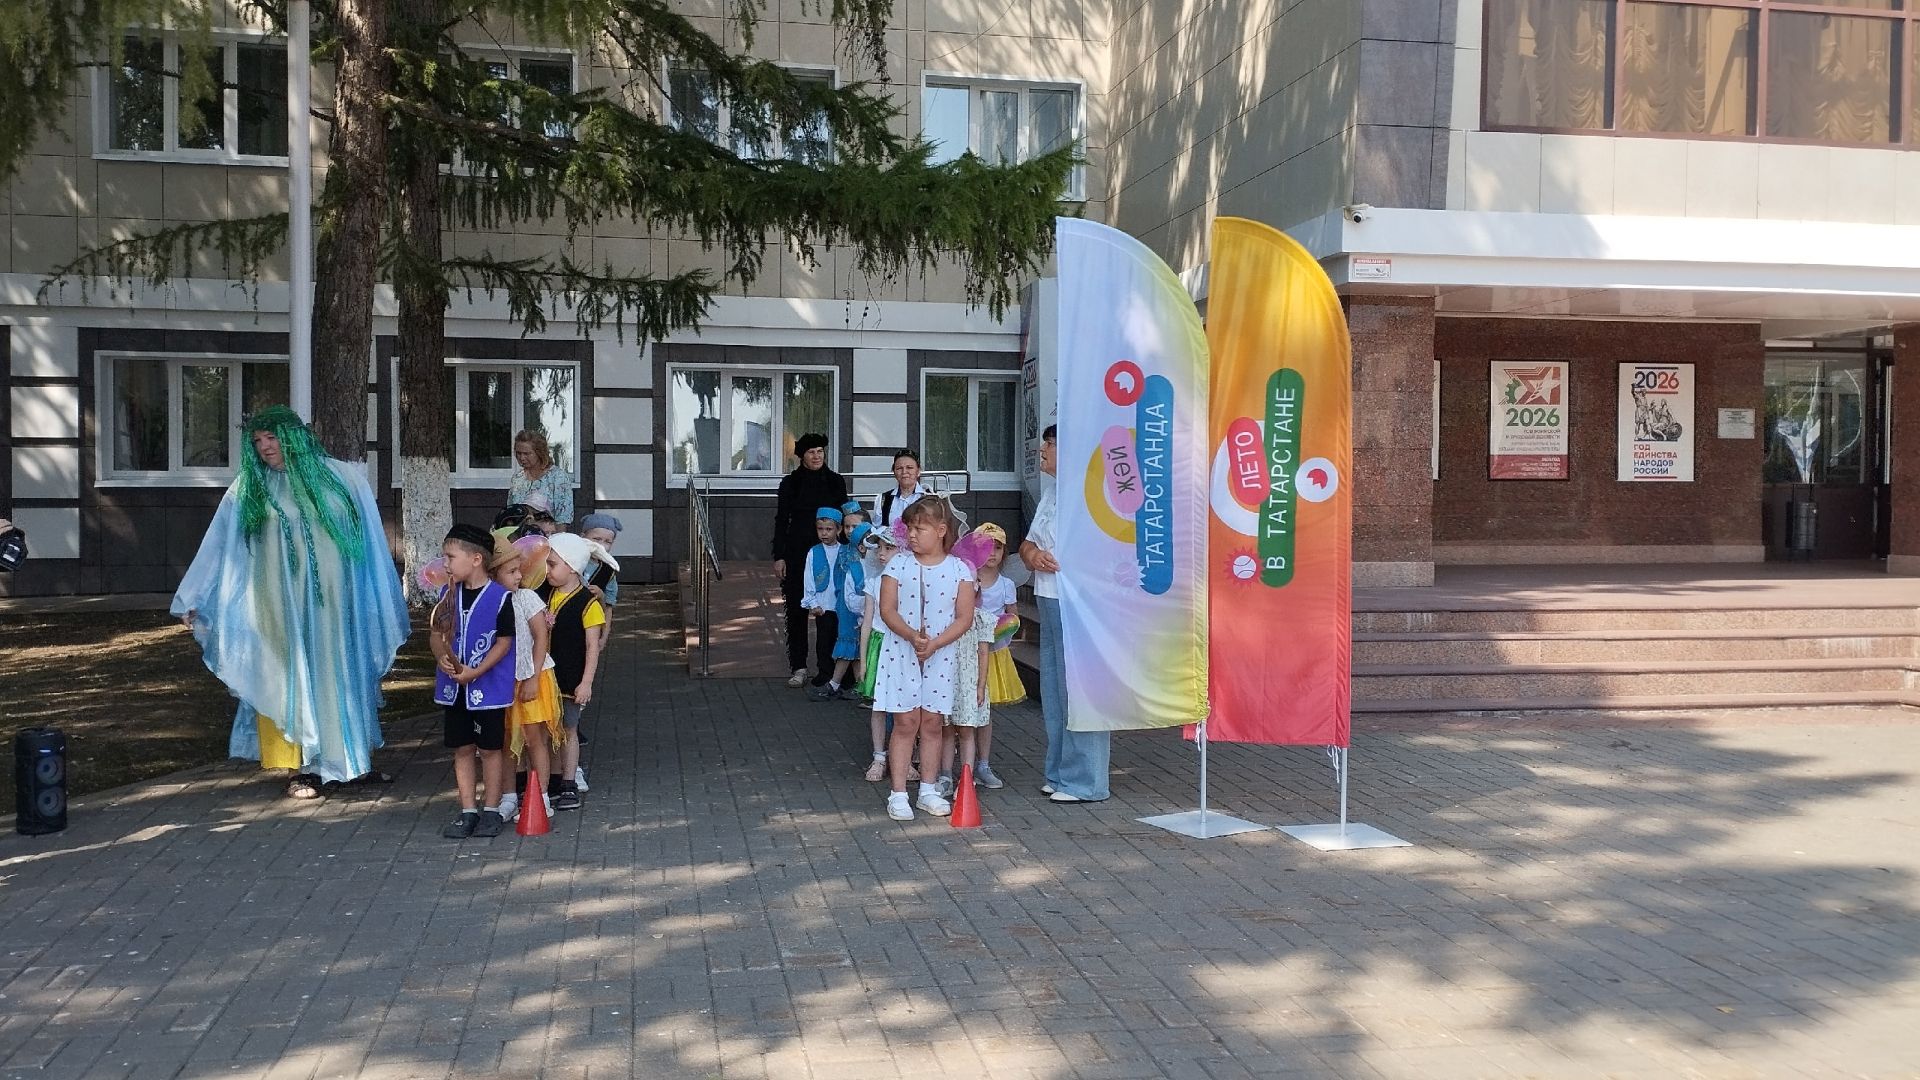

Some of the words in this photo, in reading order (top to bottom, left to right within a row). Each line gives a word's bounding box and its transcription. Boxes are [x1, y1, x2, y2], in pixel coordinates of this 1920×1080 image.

[1634, 371, 1680, 390] 2026
[1505, 407, 1560, 427] 2026
[1235, 431, 1262, 490] ЛЕТО
[1267, 388, 1295, 539] ТАТАРСТАНЕ
[1633, 451, 1678, 459] ЕДИНСТВА
[1633, 459, 1674, 467] НАРОДОВ
[1633, 467, 1669, 475] РОССИИ
[1144, 403, 1168, 568] ТАТАРСТАНДА
[1267, 556, 1285, 571] В
